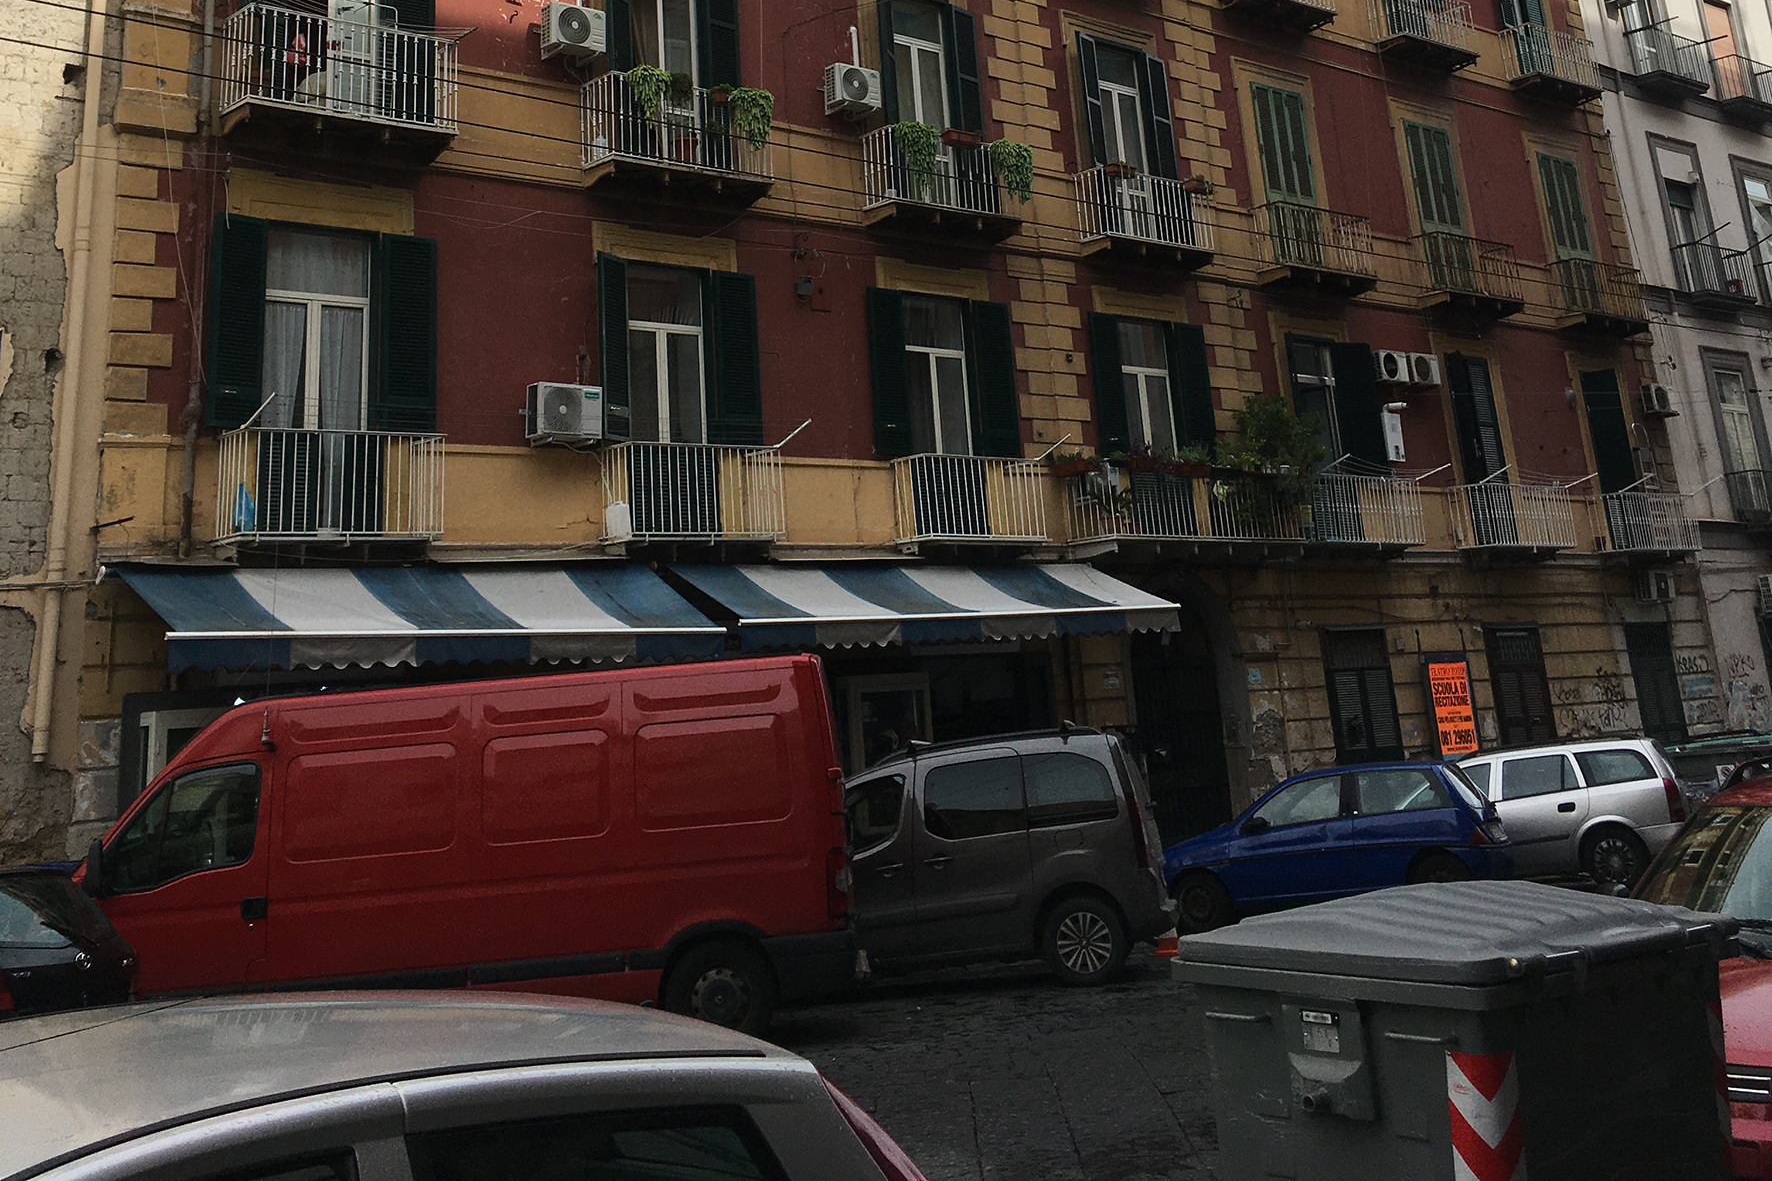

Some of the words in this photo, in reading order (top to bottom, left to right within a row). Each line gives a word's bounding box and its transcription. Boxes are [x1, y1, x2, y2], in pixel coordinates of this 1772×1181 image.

[1432, 681, 1459, 696] SCUOLA
[1460, 681, 1468, 695] DI
[1434, 695, 1470, 707] RECITAZIONE
[1440, 730, 1452, 746] 081
